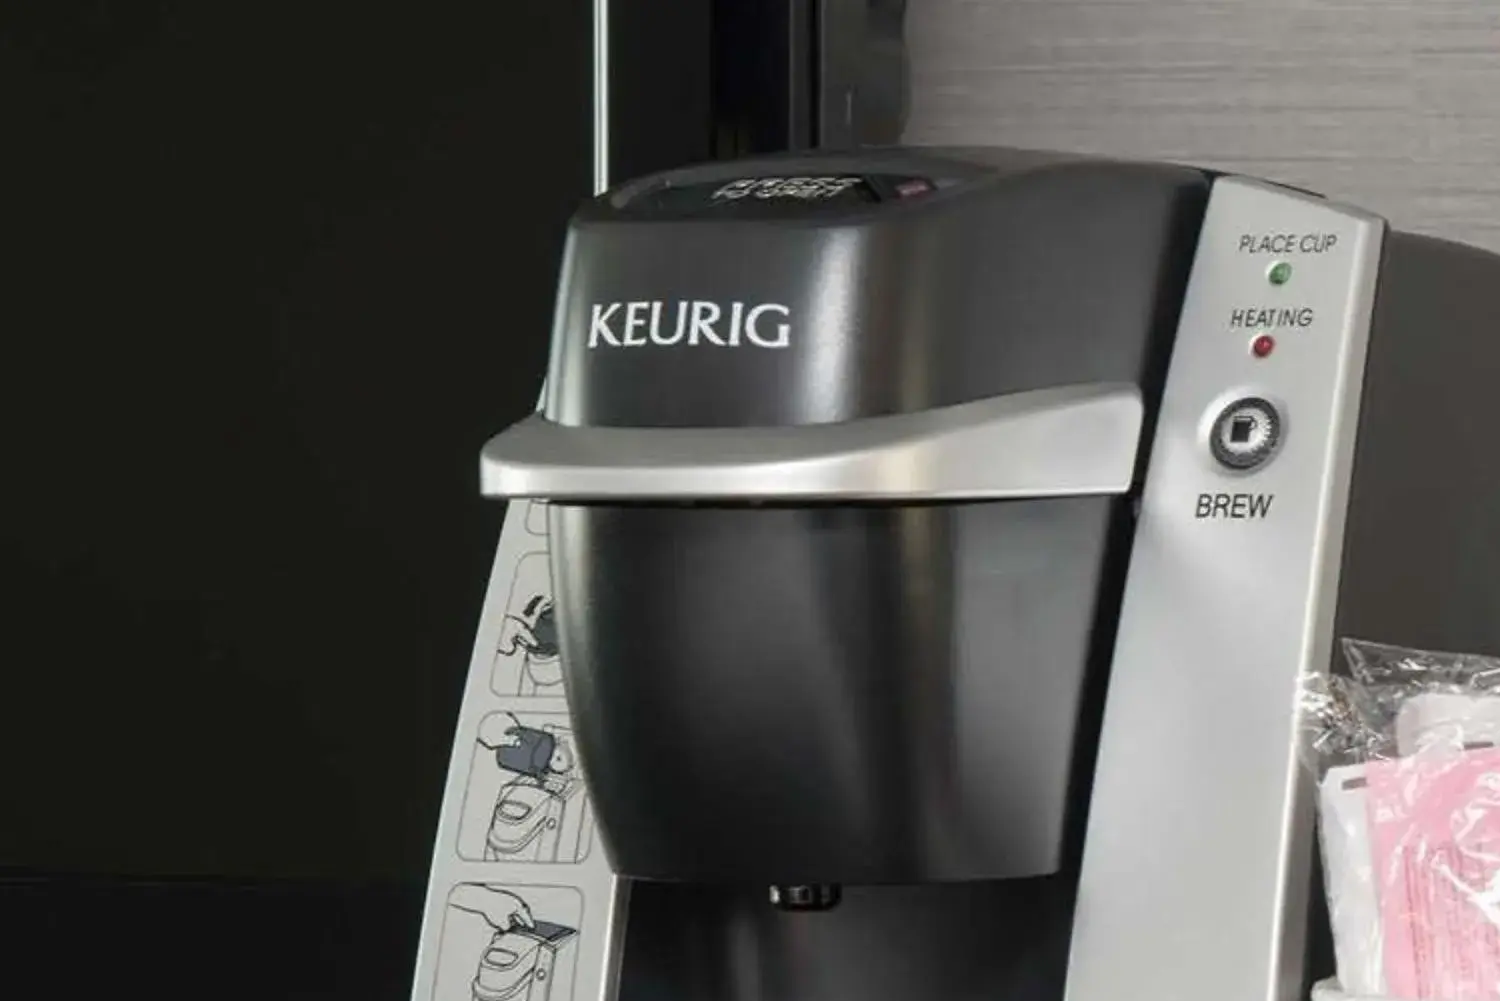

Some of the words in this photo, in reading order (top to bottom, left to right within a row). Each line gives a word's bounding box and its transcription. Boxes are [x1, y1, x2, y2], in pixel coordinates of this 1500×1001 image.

[1239, 234, 1295, 253] PLACE
[1299, 234, 1338, 253] CUP
[587, 300, 791, 349] KEURIG
[1230, 307, 1314, 328] HEATING
[1195, 493, 1275, 519] BREW
